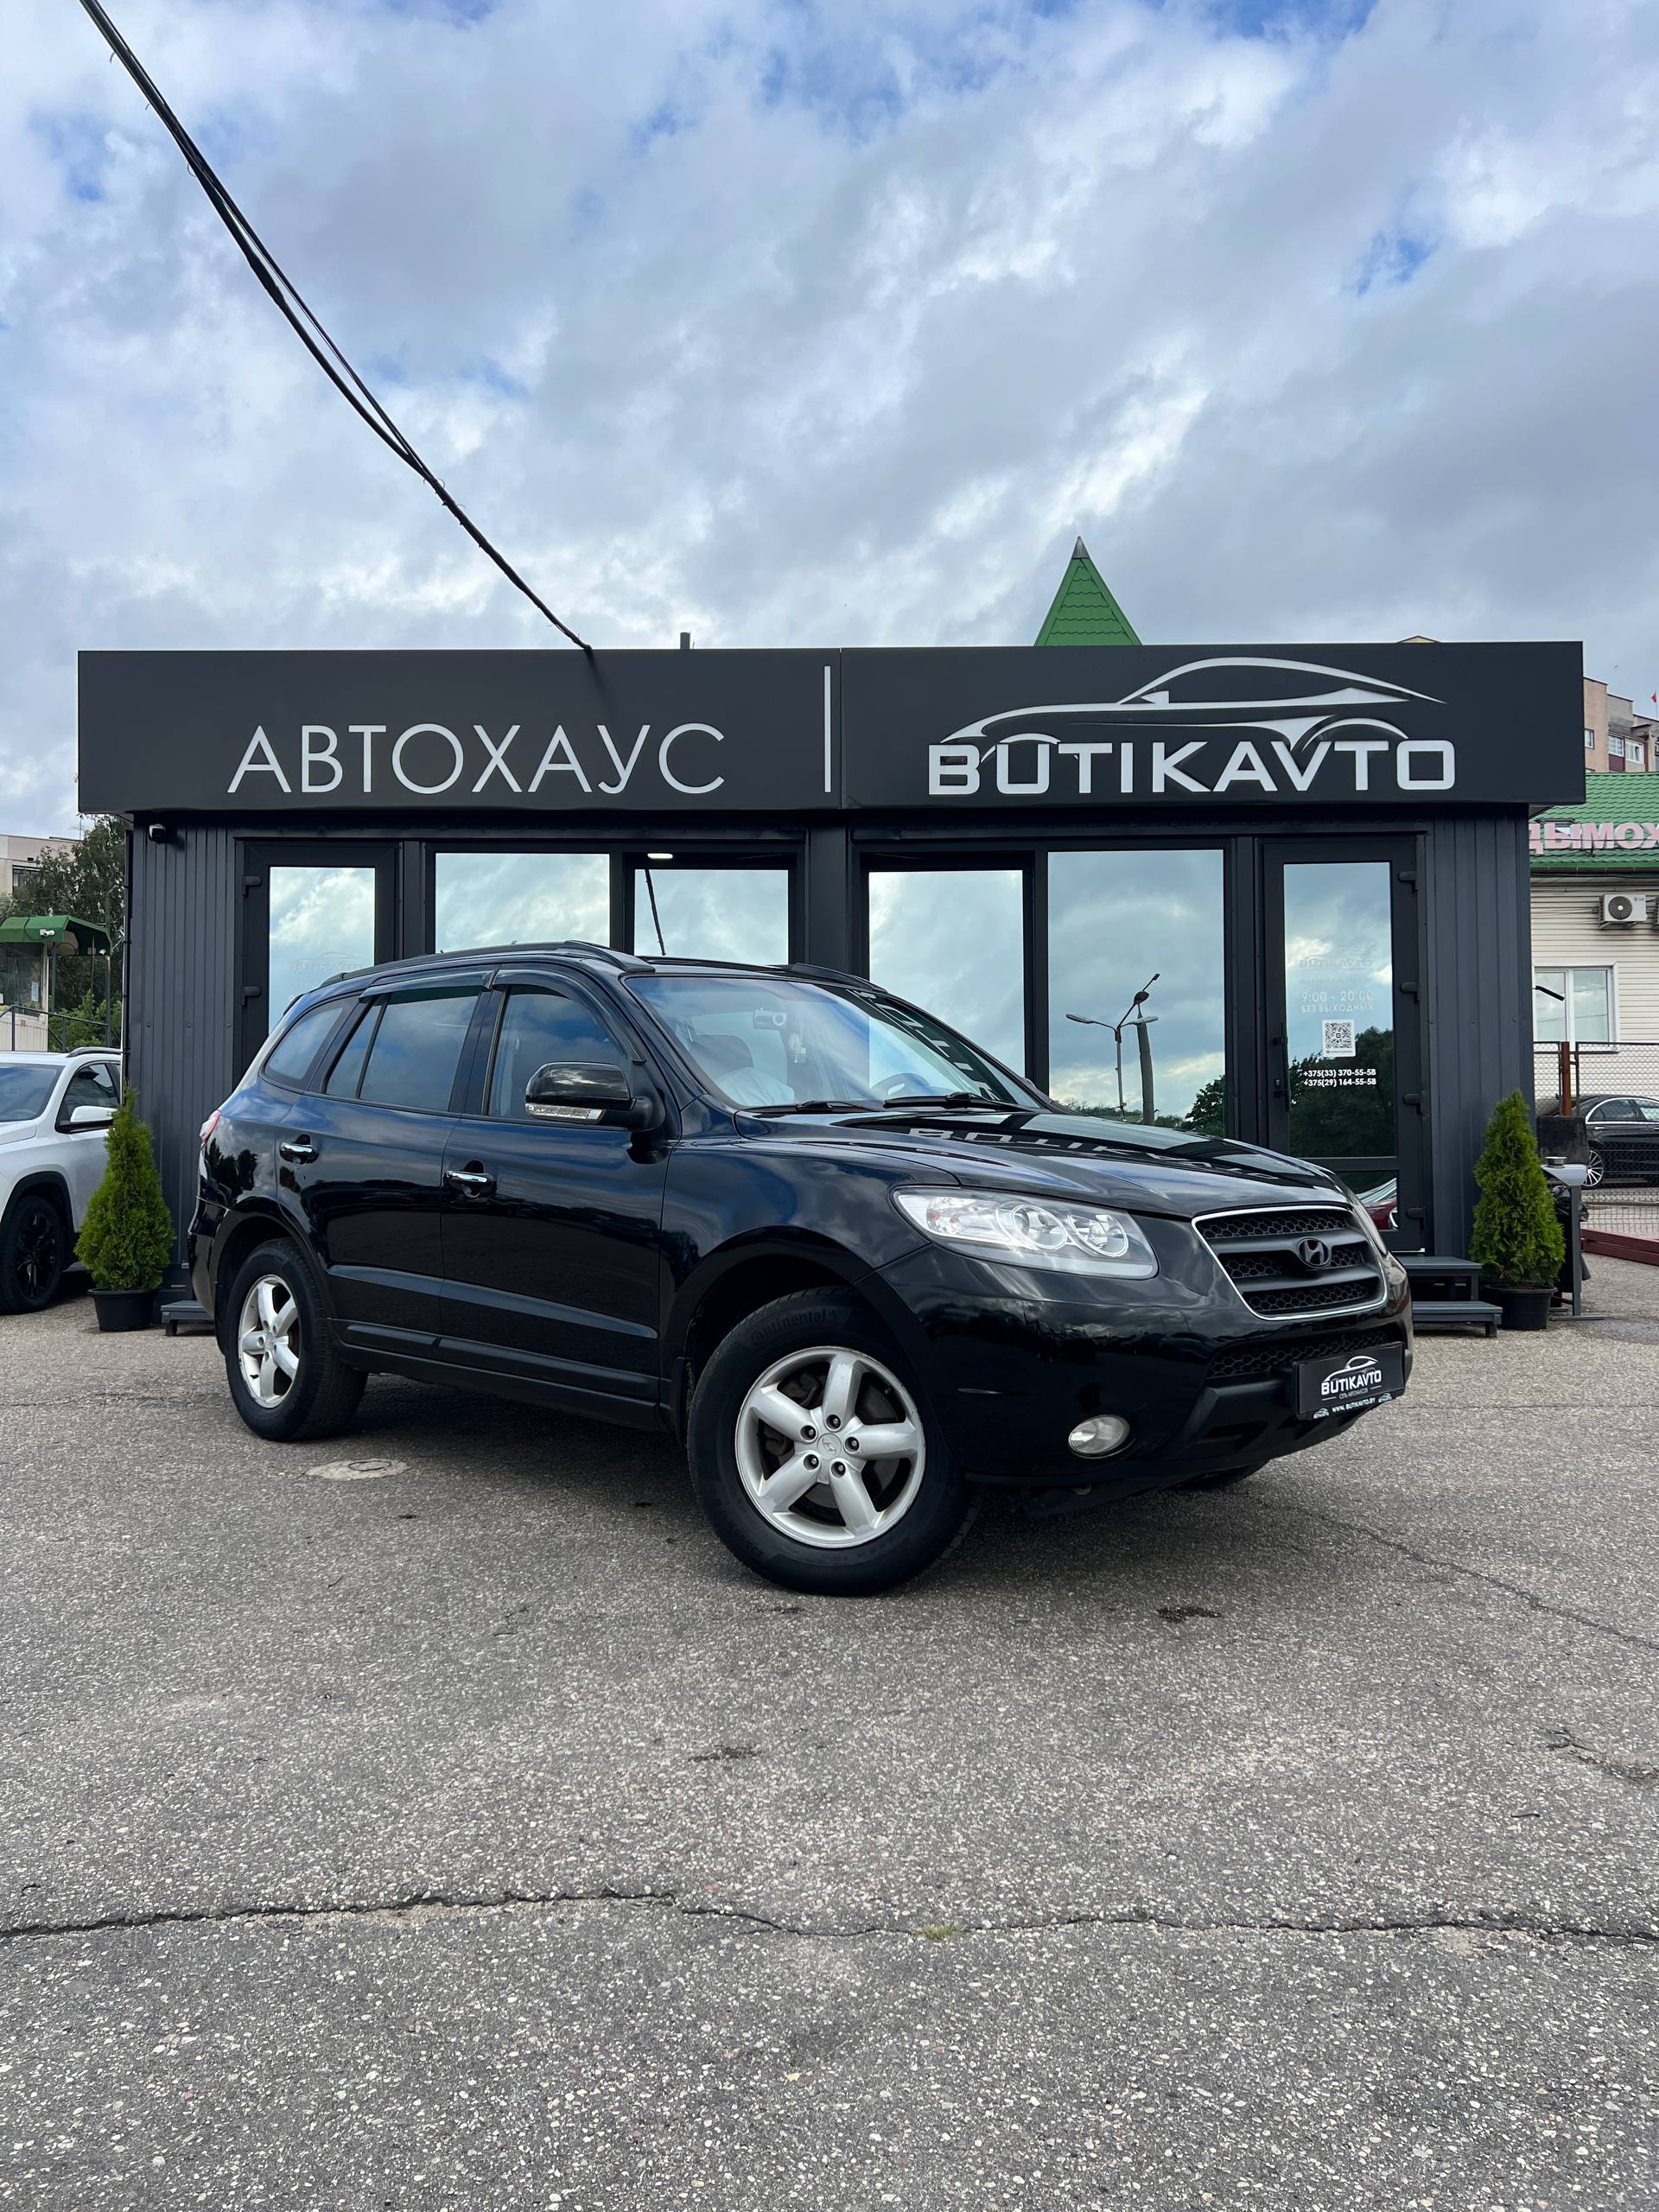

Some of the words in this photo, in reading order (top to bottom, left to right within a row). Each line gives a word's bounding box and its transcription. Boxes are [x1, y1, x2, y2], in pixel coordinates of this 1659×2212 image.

[227, 722, 726, 795] АВТОХАУС
[928, 740, 1456, 795] BUTIKAVTO
[1301, 992, 1327, 1002] 9:00
[1340, 991, 1374, 1002] 20:00
[1301, 1005, 1316, 1014] БЕЗ
[1319, 1003, 1375, 1013] ВЫХОДНЫХ
[1303, 1070, 1337, 1078] +375(33)
[1321, 1370, 1382, 1395] BUTIKAVTO
